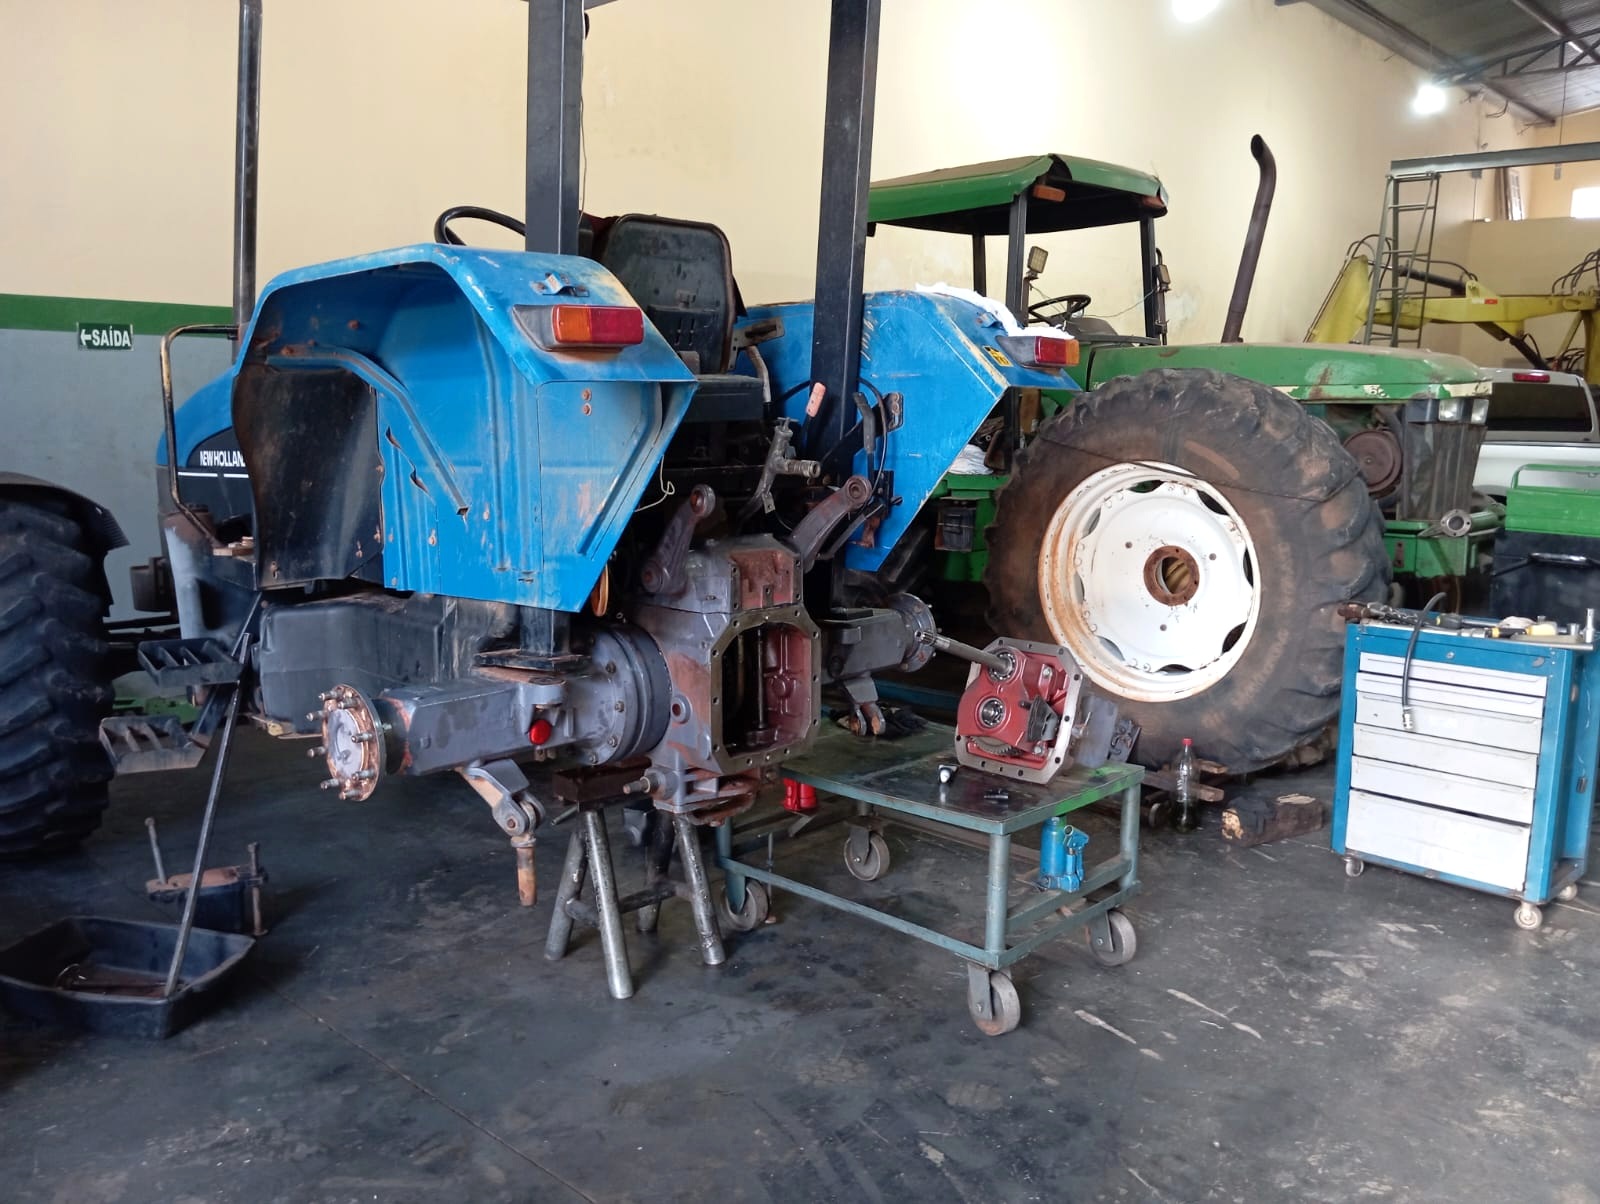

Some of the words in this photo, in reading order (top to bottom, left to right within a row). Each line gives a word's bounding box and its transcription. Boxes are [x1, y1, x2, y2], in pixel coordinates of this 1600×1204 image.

[92, 325, 131, 347] SAÍDA
[199, 450, 213, 467] NEW
[213, 450, 246, 467] HOLLAN
